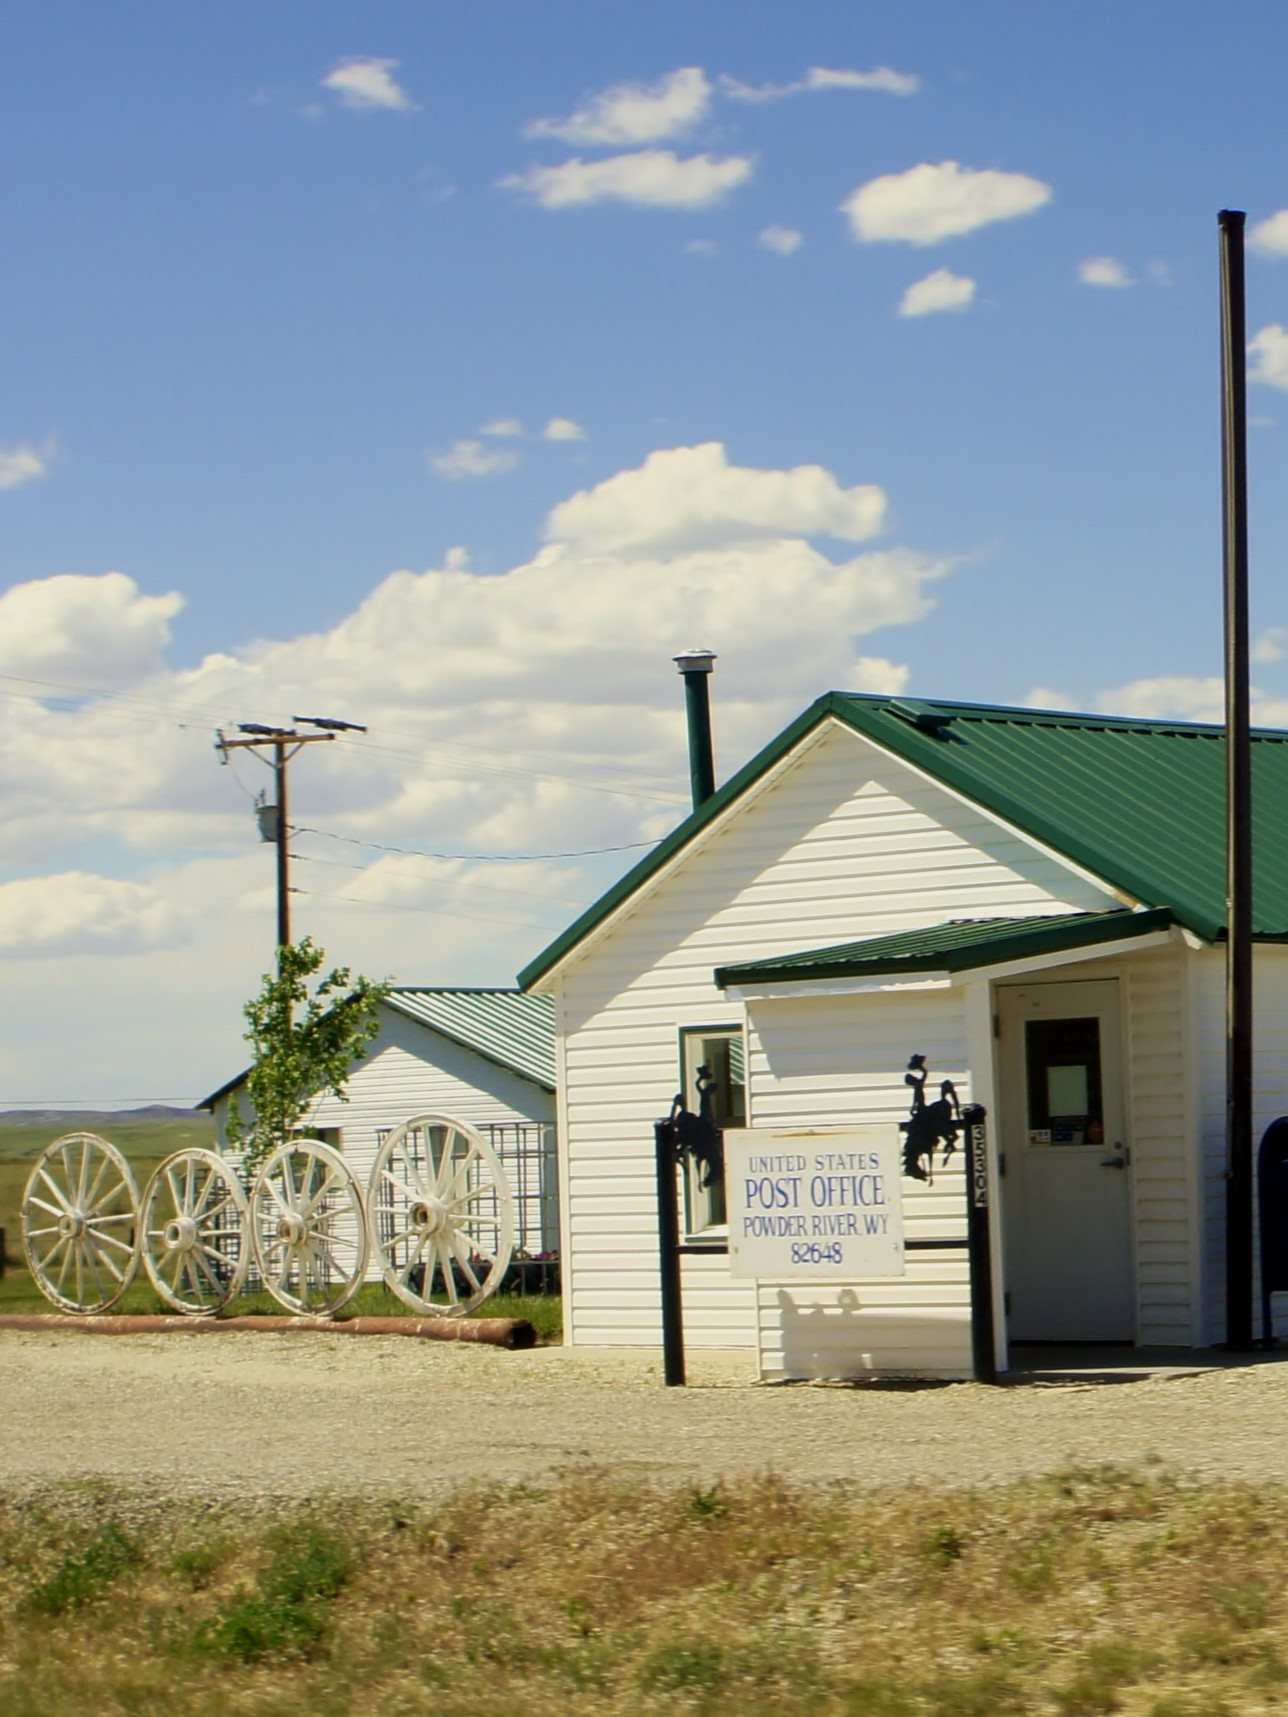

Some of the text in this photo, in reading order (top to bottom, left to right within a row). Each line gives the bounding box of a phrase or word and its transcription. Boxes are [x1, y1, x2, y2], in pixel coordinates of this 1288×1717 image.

[749, 1152, 880, 1173] UNITED STATES
[744, 1174, 886, 1209] POST OFFICE
[743, 1215, 808, 1238] POWDER
[863, 1213, 889, 1236] WY
[791, 1241, 844, 1265] 82648
